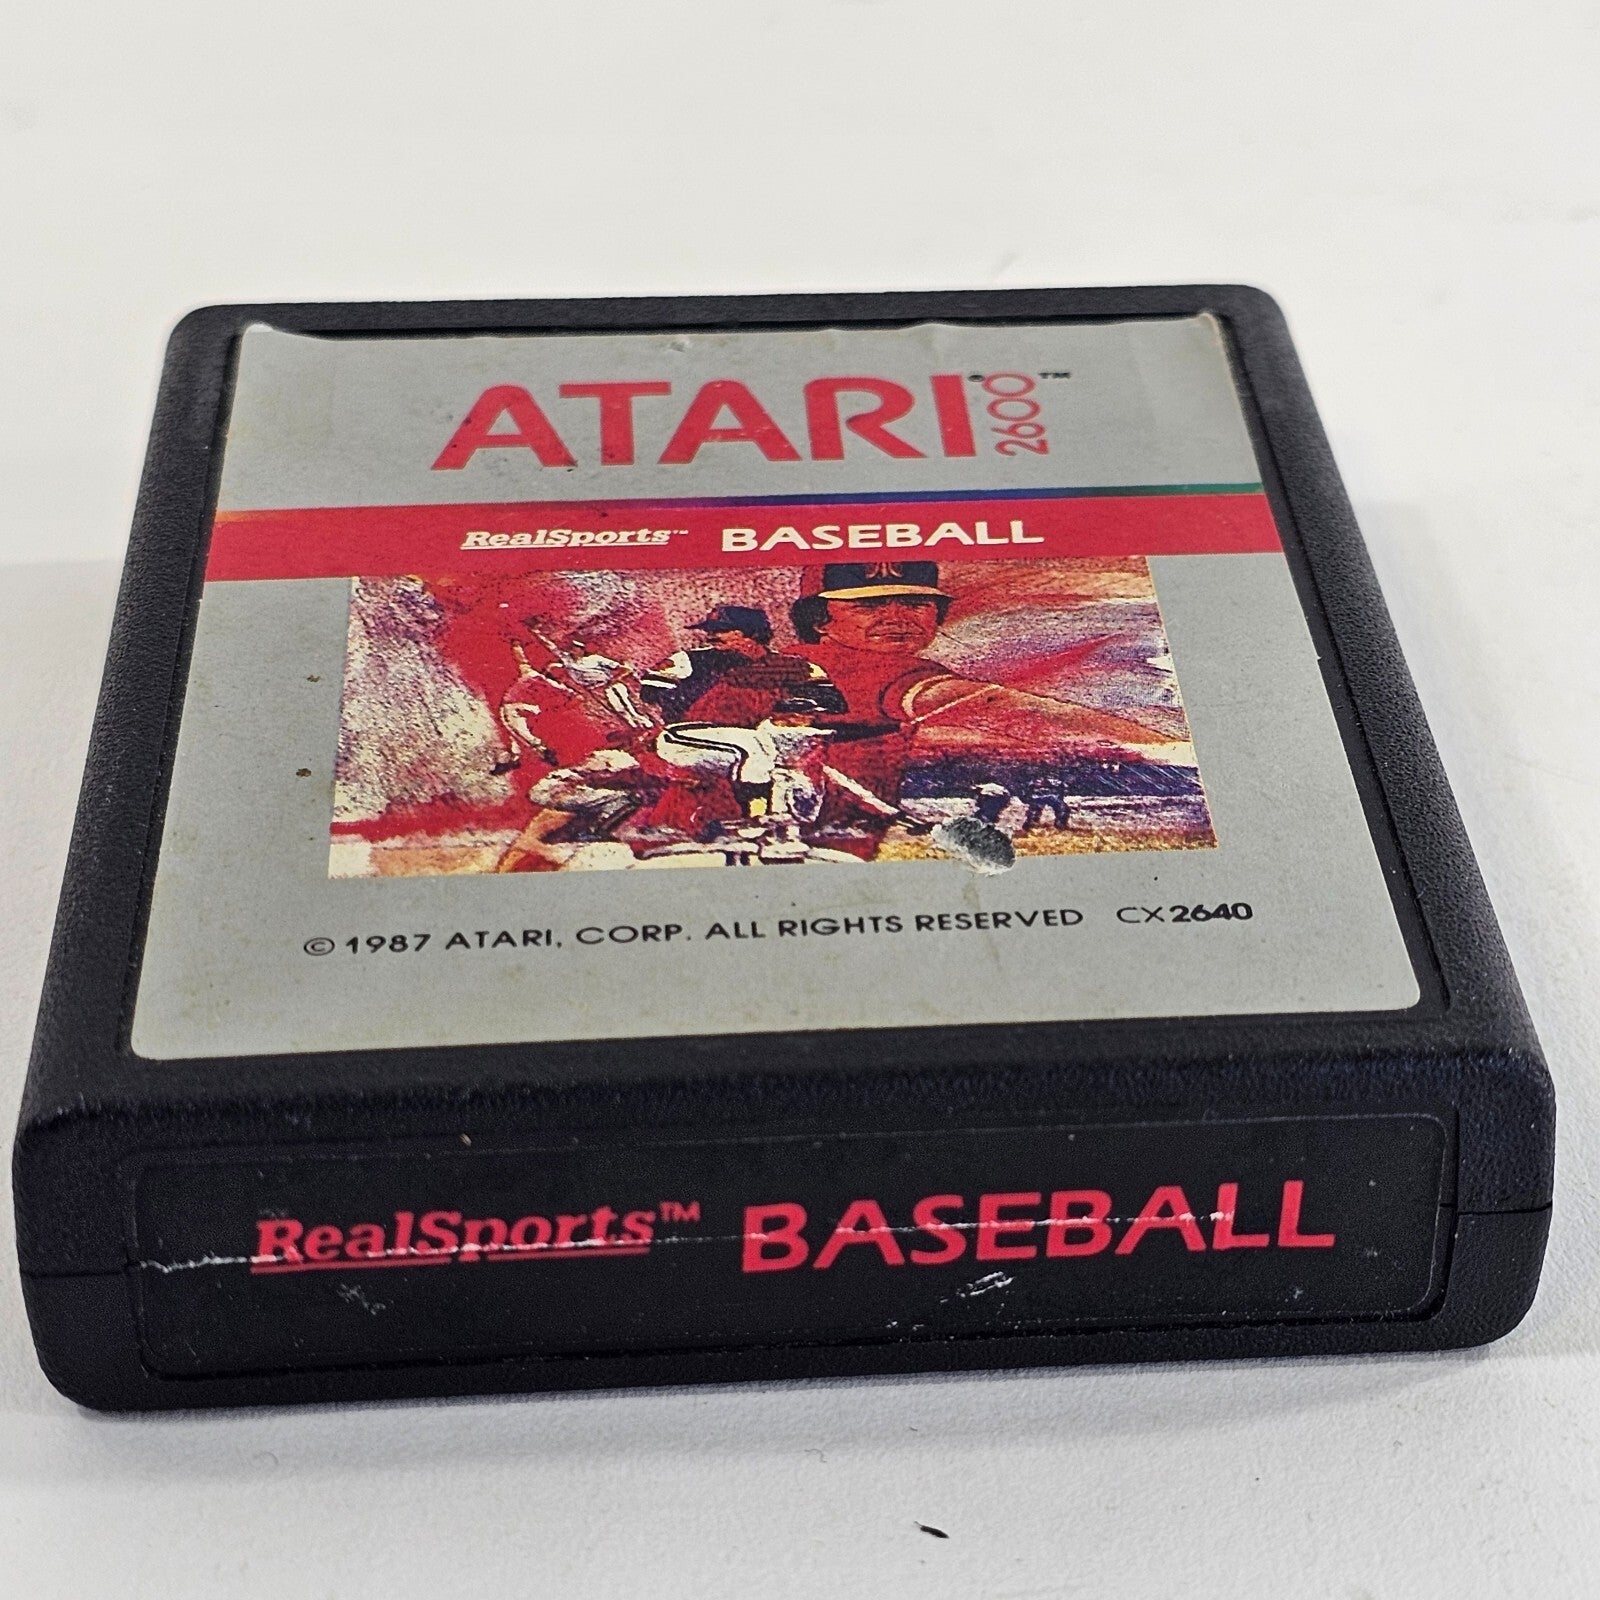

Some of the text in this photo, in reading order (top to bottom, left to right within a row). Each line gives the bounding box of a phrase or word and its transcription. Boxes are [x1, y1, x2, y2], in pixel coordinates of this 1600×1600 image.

[981, 372, 1050, 457] 2600
[721, 520, 1045, 553] BASEBALL
[346, 933, 432, 954] 1987
[445, 929, 563, 950] ATARI,
[576, 923, 693, 945] CORP.
[705, 920, 767, 941] ALL
[778, 914, 903, 938] RIGHTS
[915, 908, 1084, 933] RESERVED
[1116, 902, 1253, 924] CX2640
[742, 1179, 1336, 1273] BASEBALL
